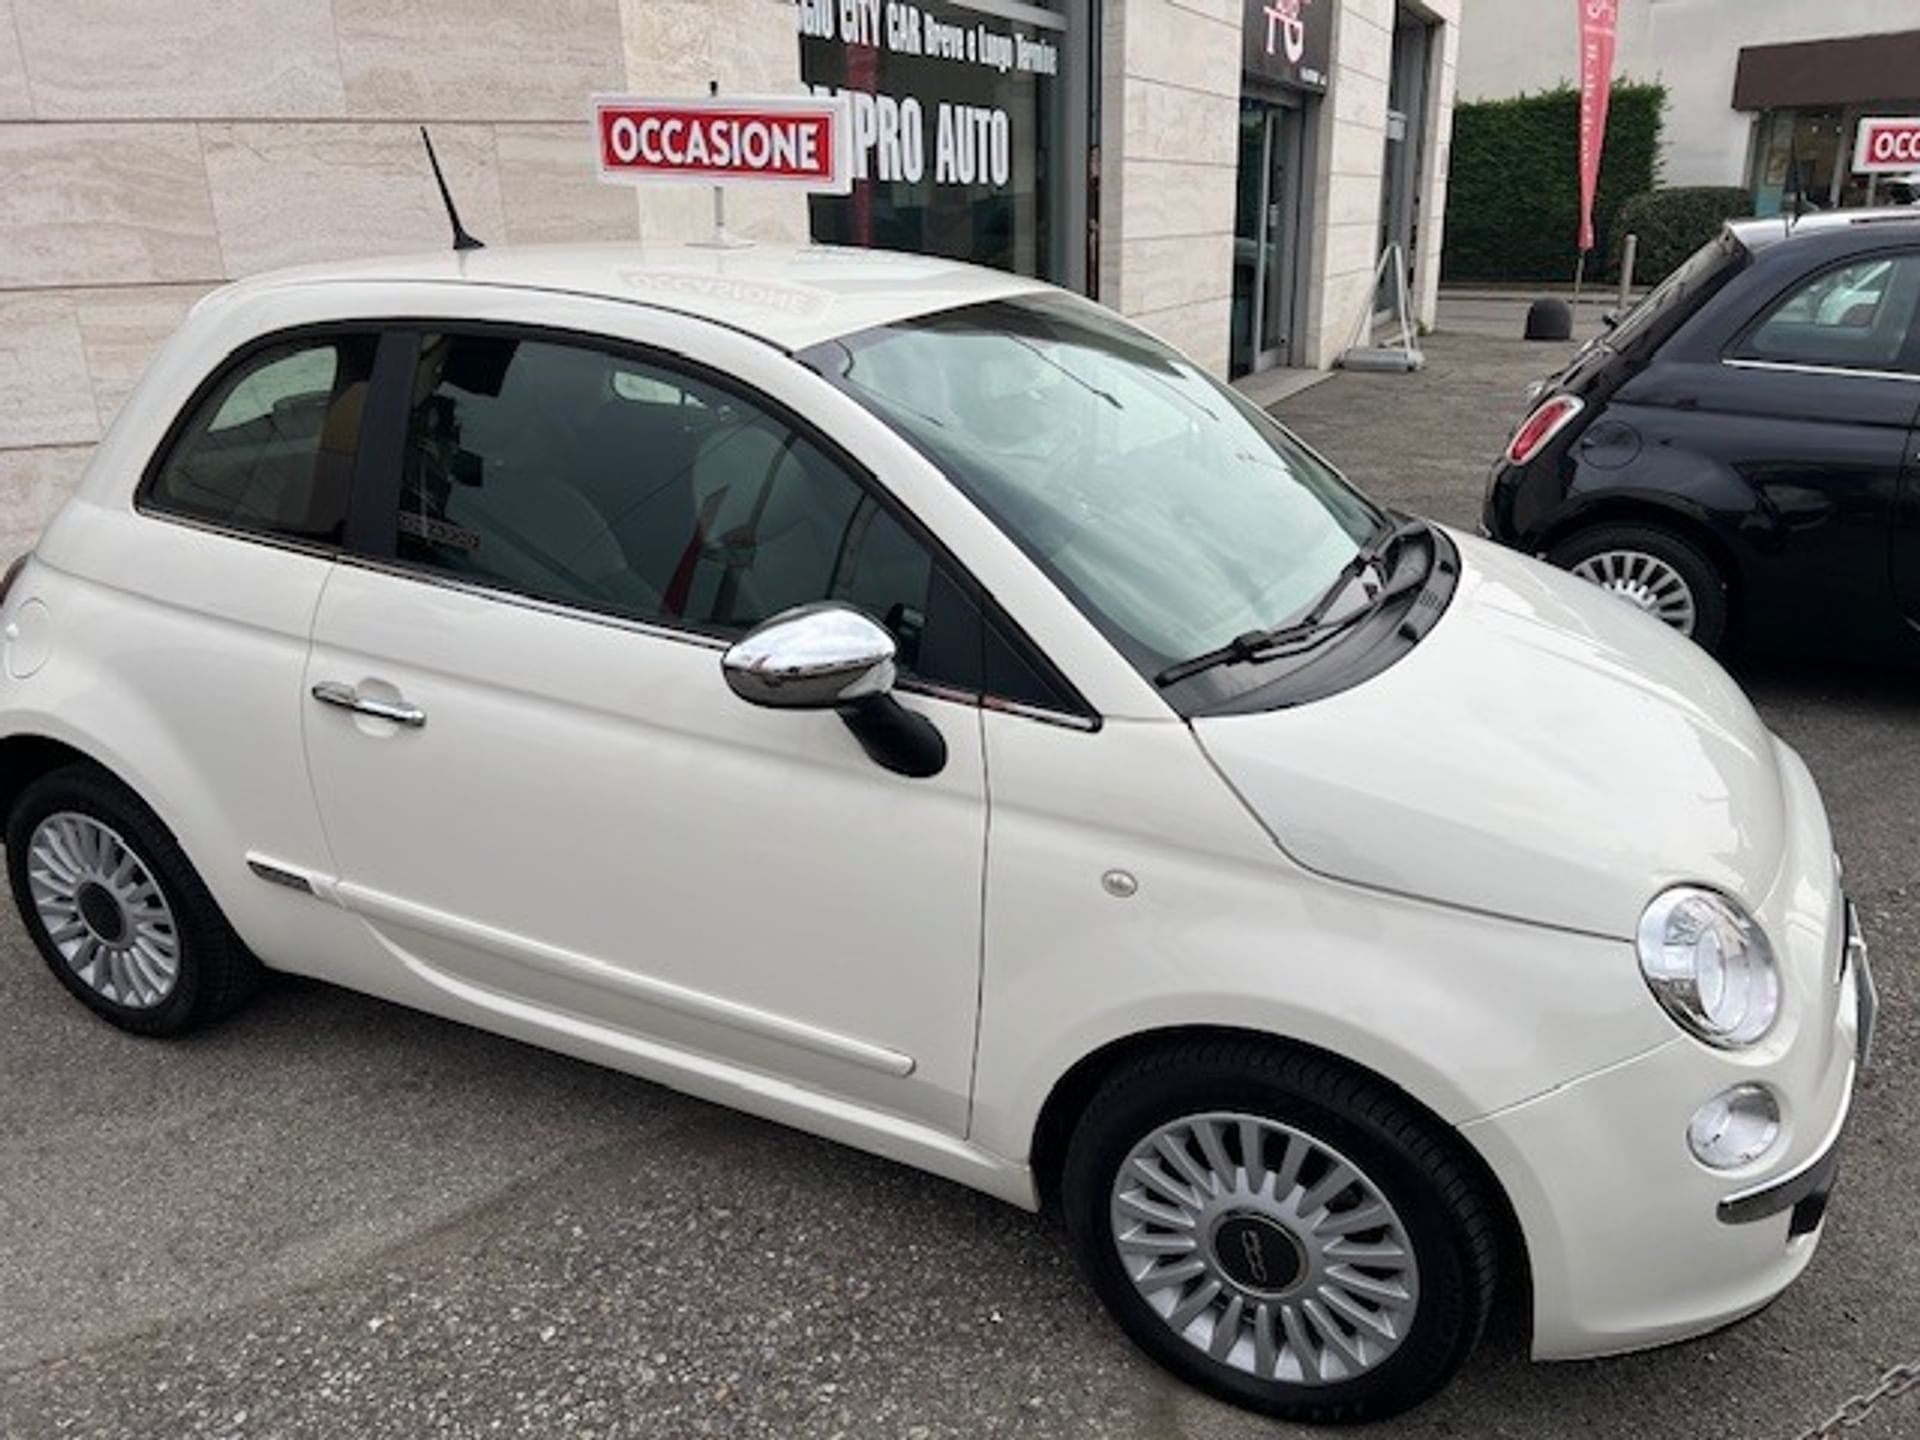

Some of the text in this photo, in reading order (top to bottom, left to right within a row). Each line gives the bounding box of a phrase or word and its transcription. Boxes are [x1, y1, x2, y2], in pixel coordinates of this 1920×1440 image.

[840, 0, 880, 47] CITY
[886, 2, 923, 55] CAR
[611, 116, 820, 170] OCCASIONE
[936, 102, 1009, 186] AUTO
